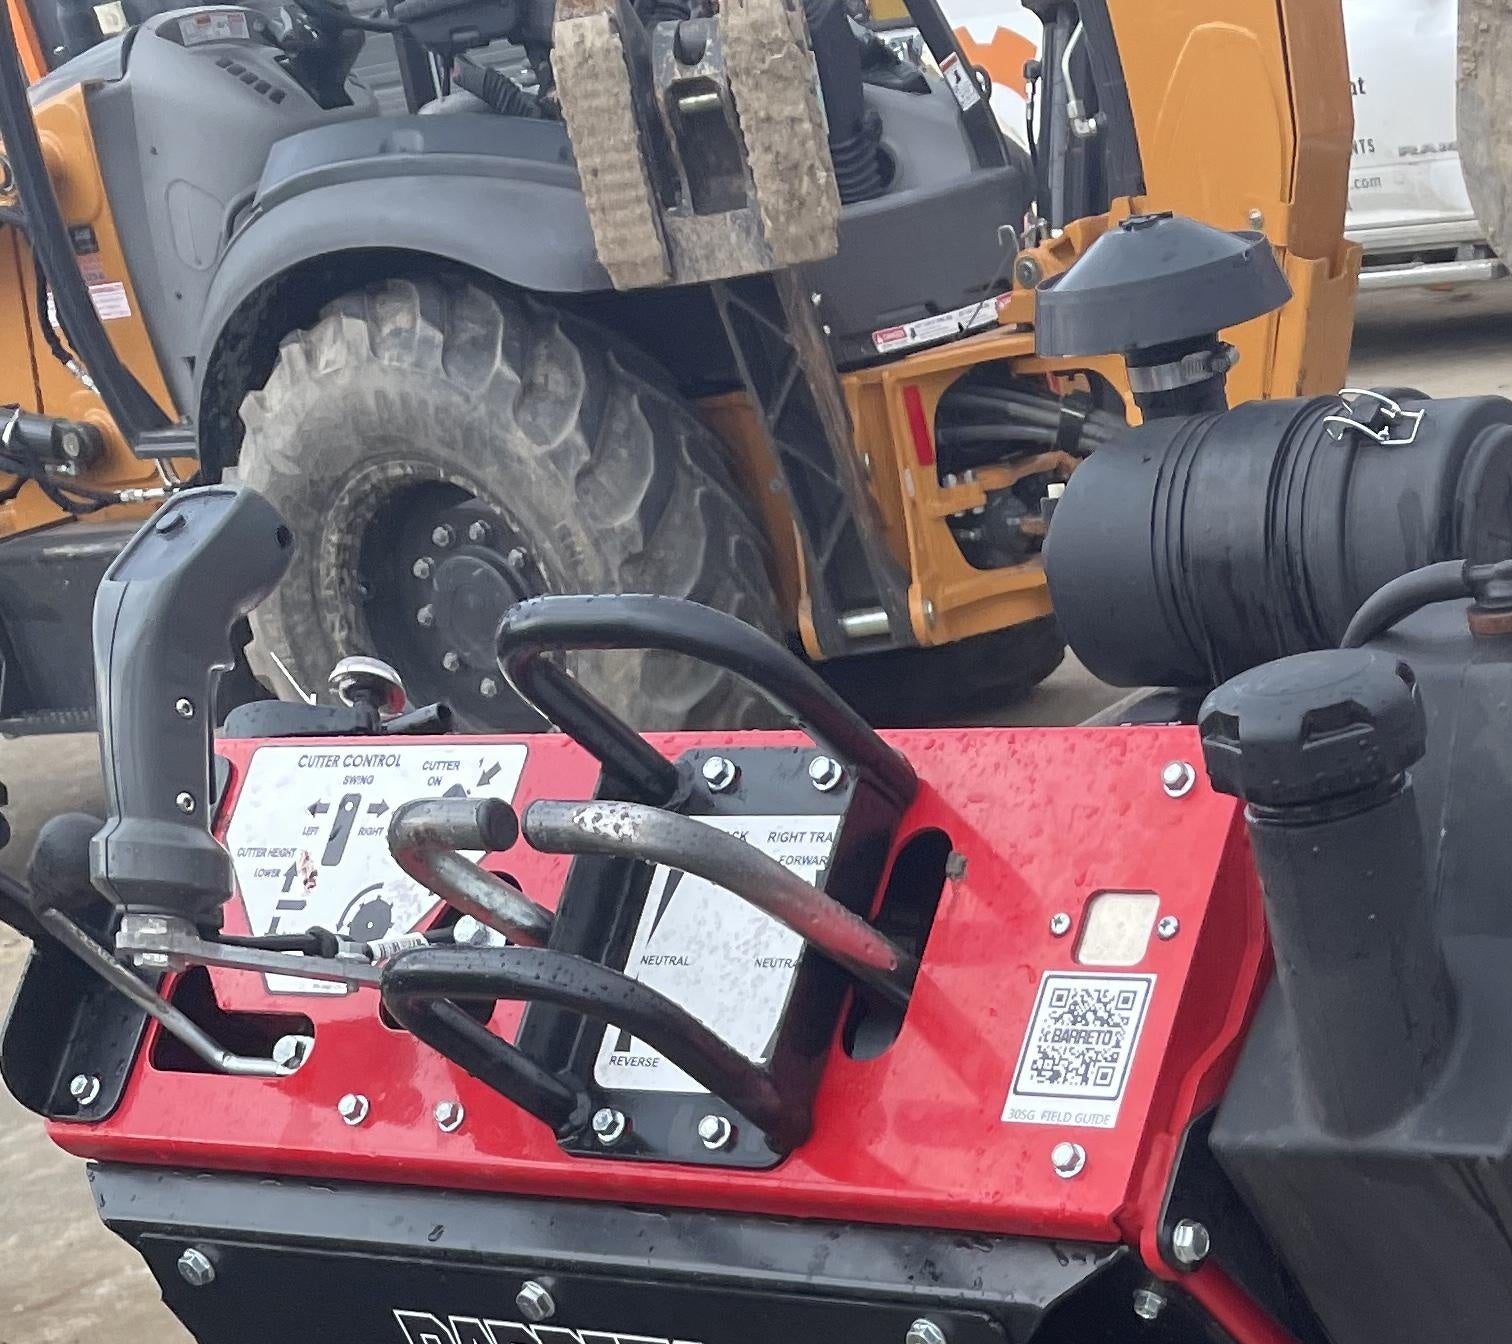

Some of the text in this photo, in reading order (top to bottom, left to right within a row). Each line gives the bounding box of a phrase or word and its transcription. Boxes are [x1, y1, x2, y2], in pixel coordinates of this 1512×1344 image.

[298, 754, 401, 769] CUTTER CONTROL
[422, 760, 460, 771] CUTTER
[342, 775, 374, 785] SWING
[427, 776, 442, 787] ON
[302, 827, 320, 836] LEFT
[358, 827, 385, 837] RIGHT
[767, 831, 833, 843] RIGHT TRA
[237, 848, 298, 858] CUTTER HEIGHT
[780, 855, 829, 866] FORWAR
[254, 867, 281, 878] LOWER
[639, 955, 690, 967] NEUTRAL
[754, 957, 800, 969] NEUTRA
[1050, 1027, 1114, 1046] BARRETO
[609, 1054, 661, 1068] REVERSE
[1008, 1108, 1112, 1126] 30SG FIELD GUIDE
